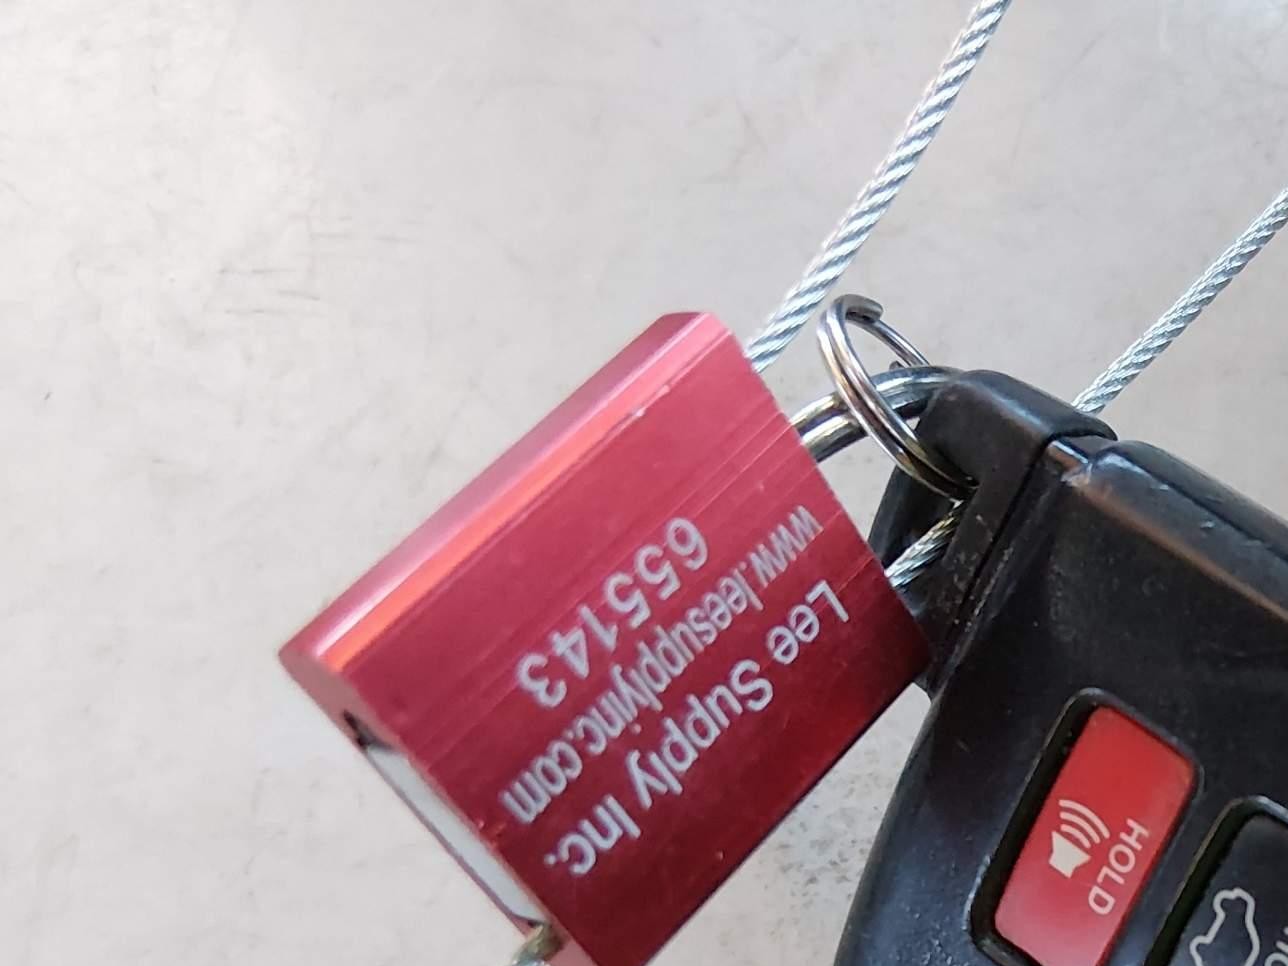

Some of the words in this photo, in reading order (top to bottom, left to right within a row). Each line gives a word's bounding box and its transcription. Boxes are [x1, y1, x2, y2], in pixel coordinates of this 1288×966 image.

[500, 505, 823, 823] www.leesupplyinc.com
[516, 517, 708, 707] 655143
[768, 580, 849, 665] Lee
[627, 660, 773, 808] Supply
[544, 795, 641, 874] Inc.
[1088, 818, 1150, 915] HOLD
